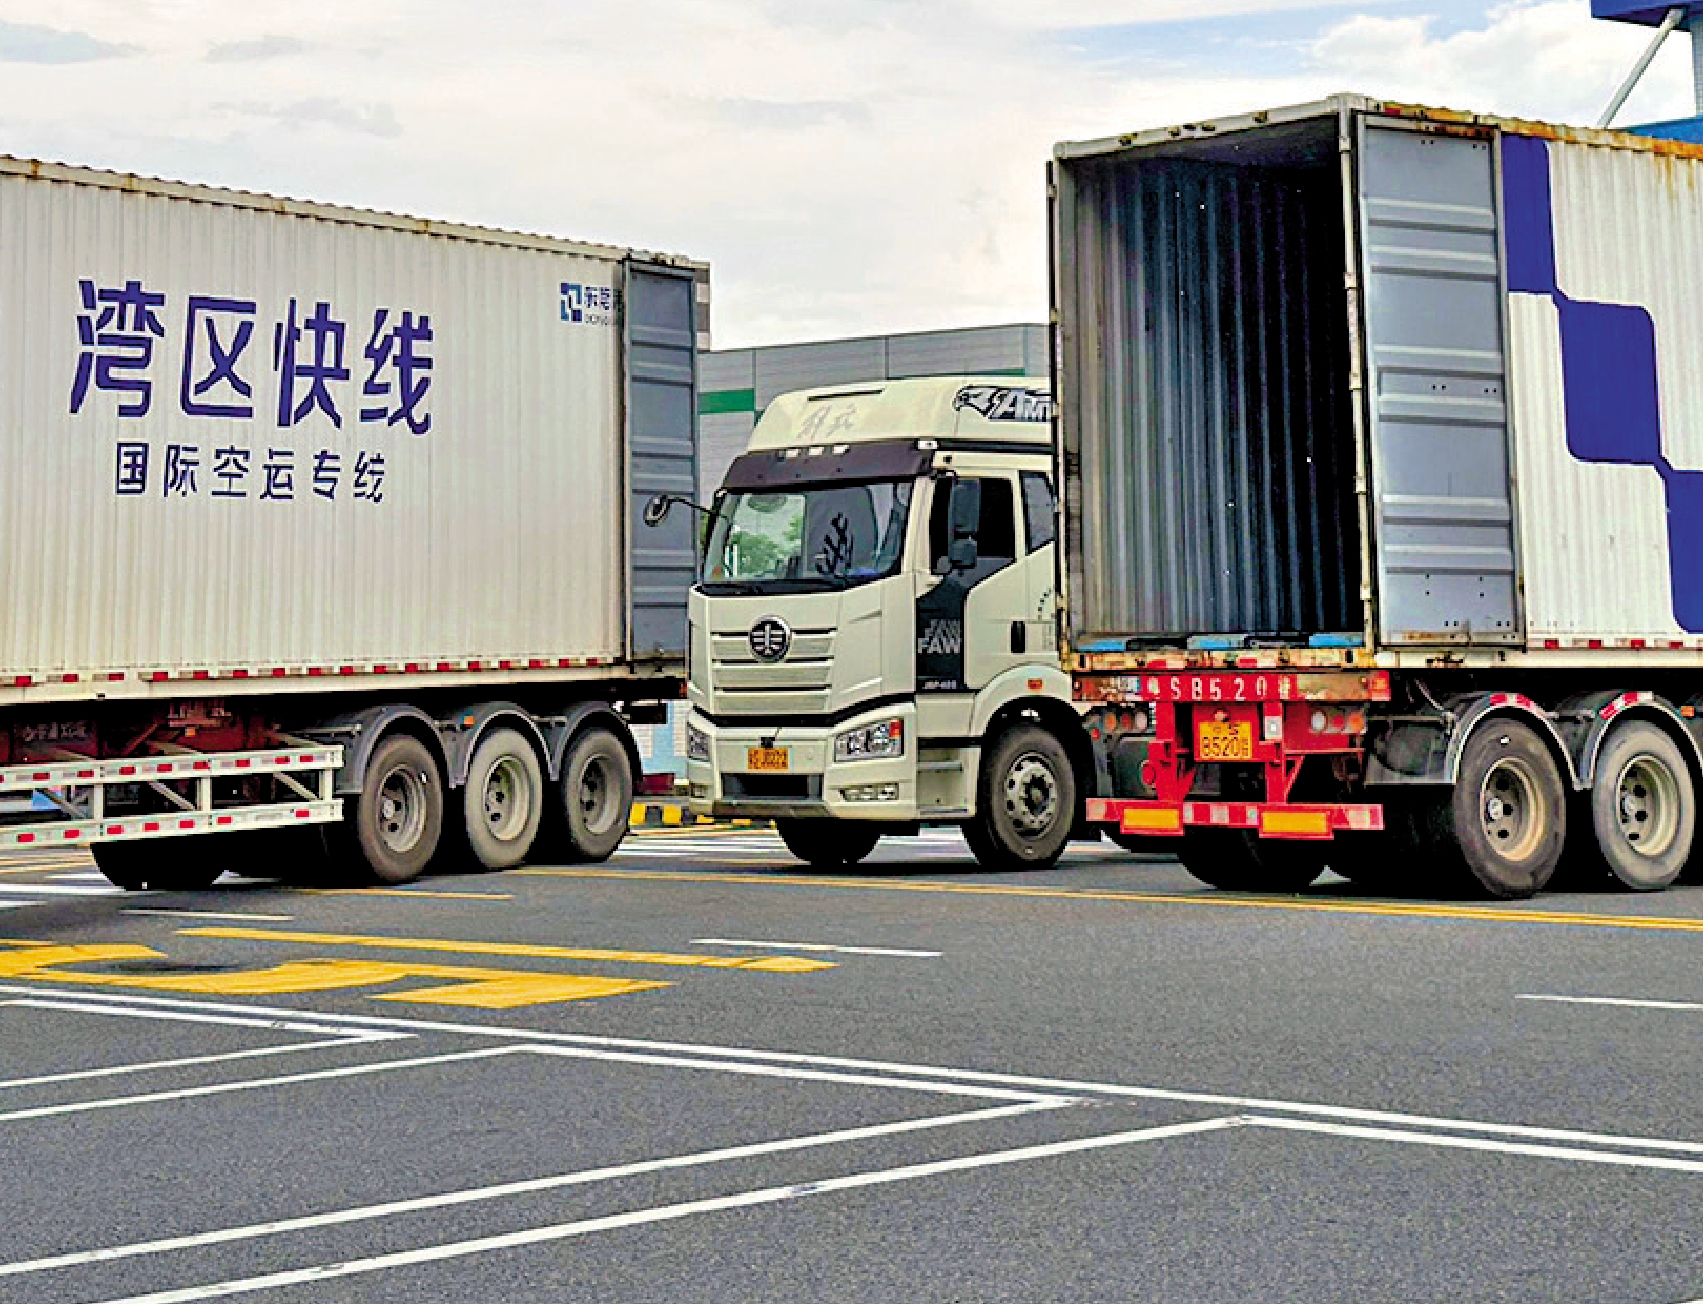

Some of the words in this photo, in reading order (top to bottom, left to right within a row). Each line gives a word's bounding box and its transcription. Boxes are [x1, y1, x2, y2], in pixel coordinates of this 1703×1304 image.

[70, 279, 434, 435] 湾区快线
[115, 441, 386, 504] 国际空运专线
